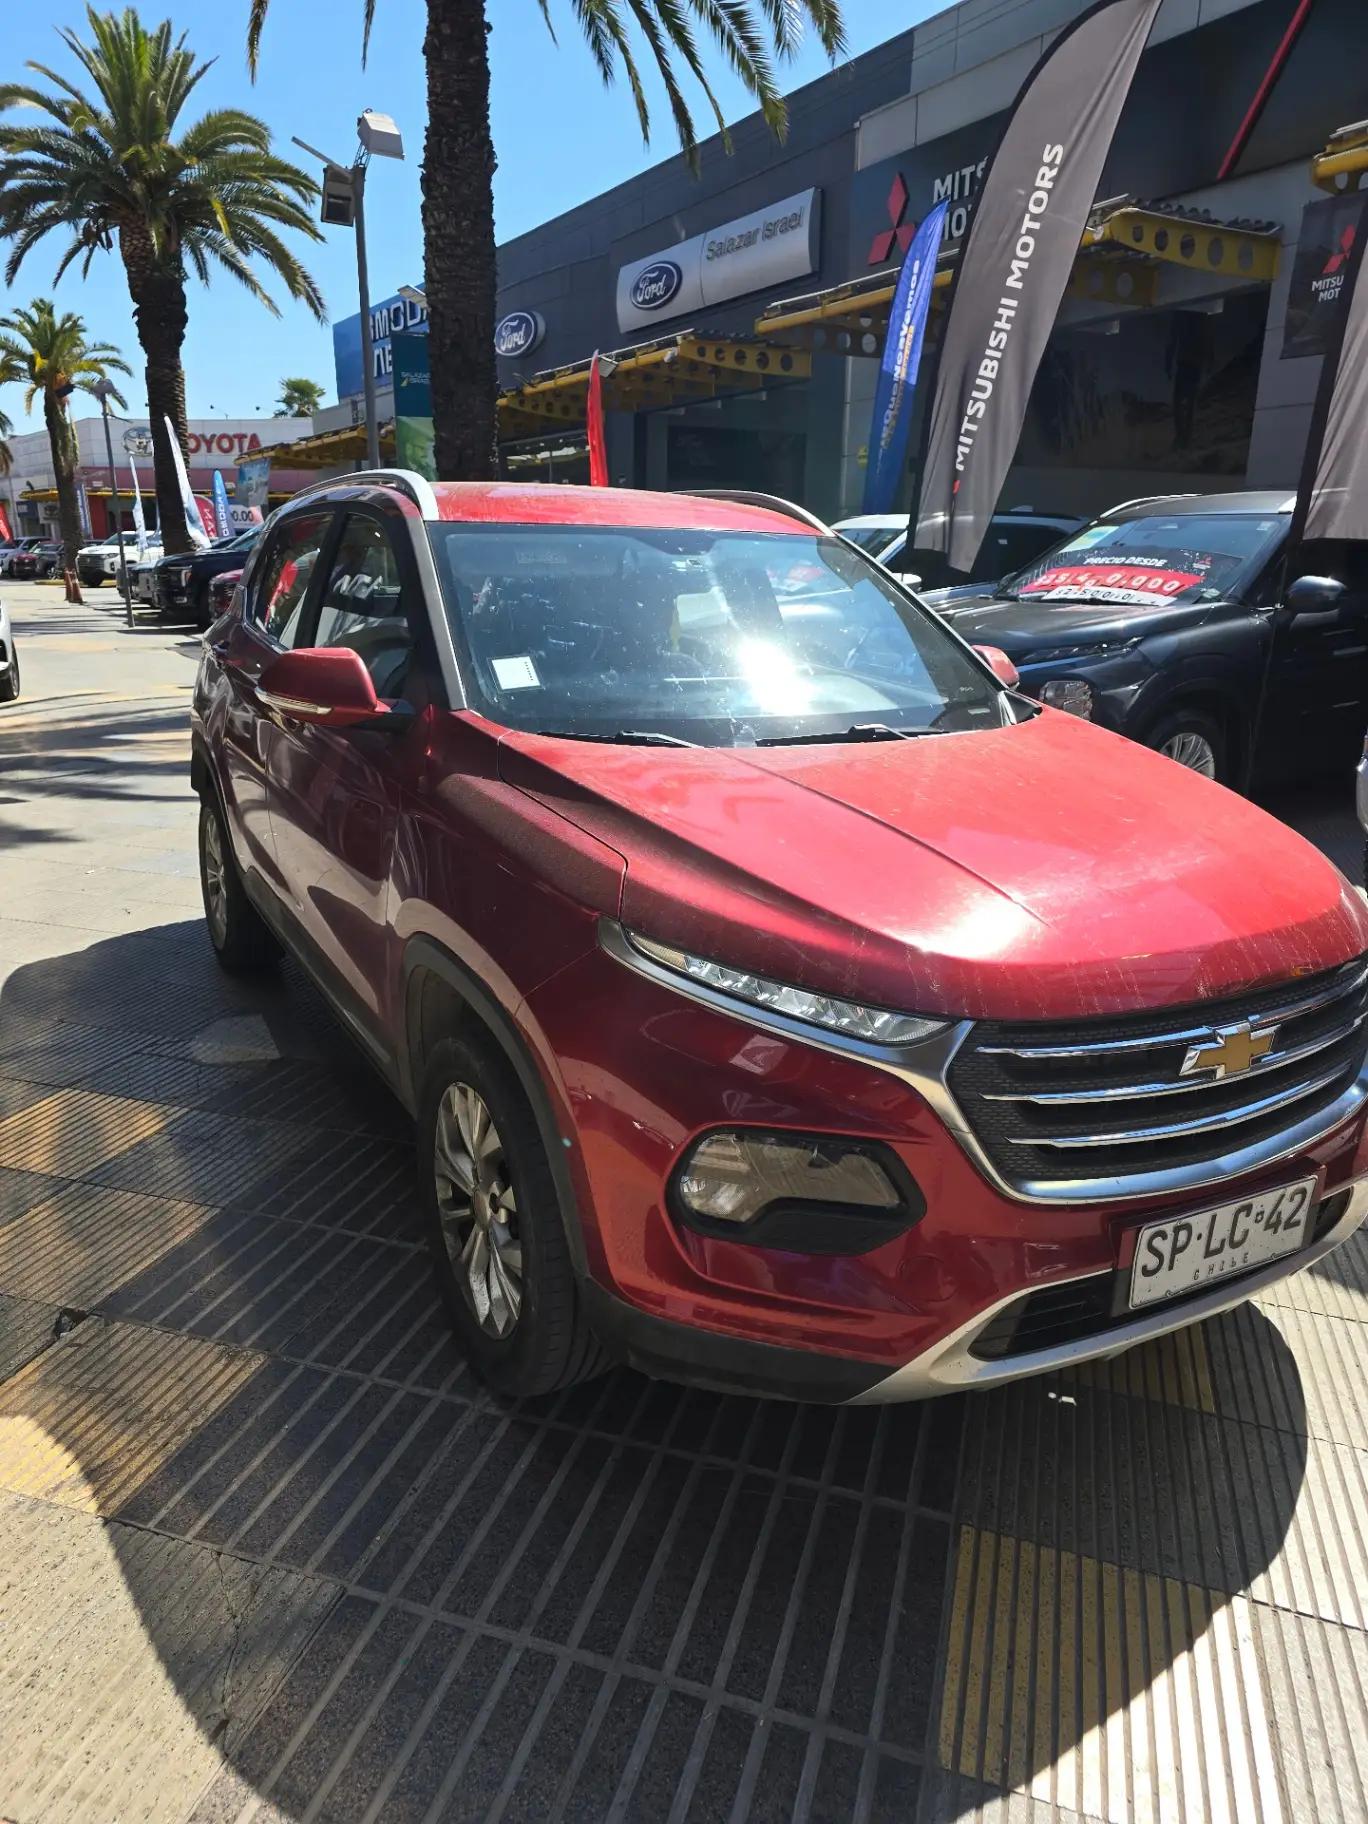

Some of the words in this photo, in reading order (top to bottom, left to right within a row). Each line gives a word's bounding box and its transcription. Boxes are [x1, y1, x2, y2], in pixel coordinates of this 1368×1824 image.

[705, 226, 761, 261] Salazar
[636, 272, 668, 302] Ford
[369, 298, 427, 341] MOD
[955, 298, 1019, 471] MITSUBISHI
[1005, 143, 1065, 289] MOTORS
[1083, 556, 1126, 565] PRECIO
[1125, 556, 1168, 567] DESDE
[1193, 1252, 1249, 1281] CHILE
